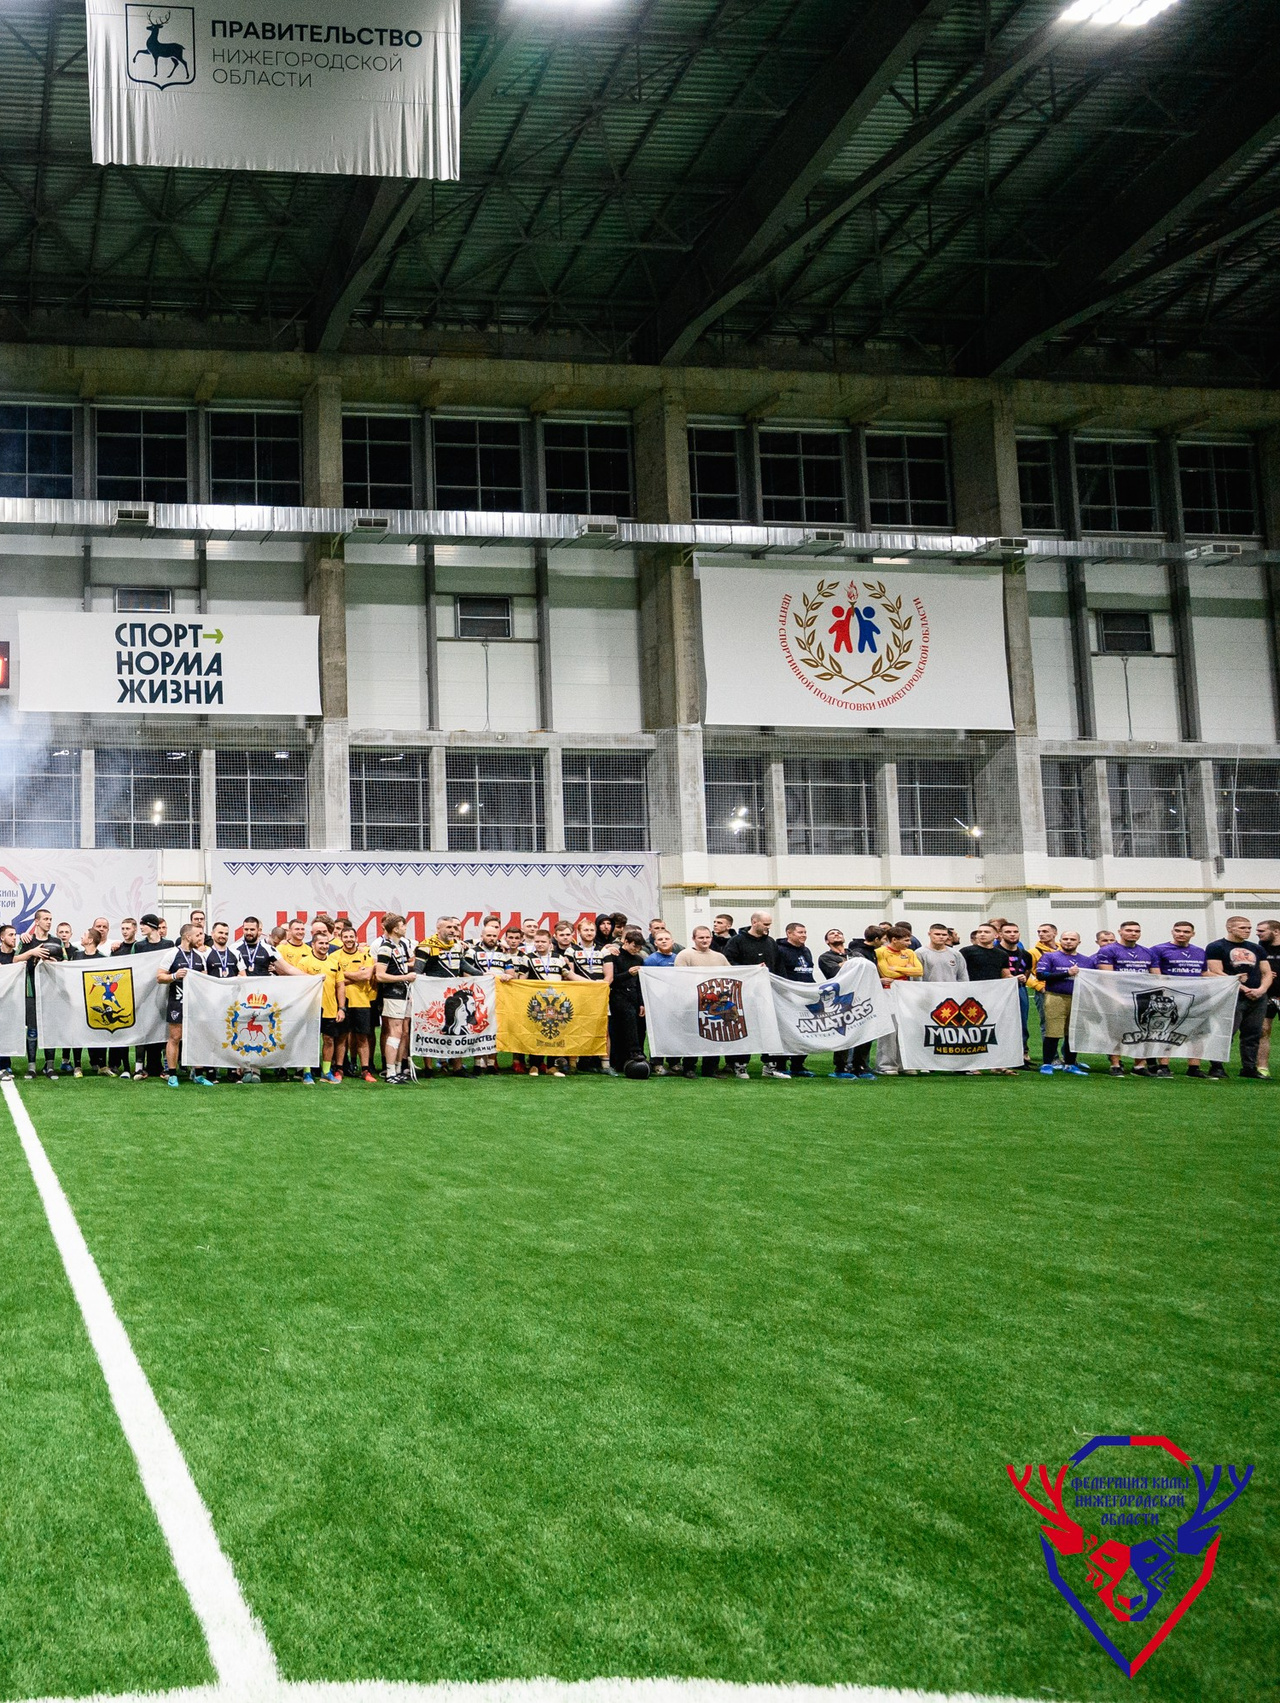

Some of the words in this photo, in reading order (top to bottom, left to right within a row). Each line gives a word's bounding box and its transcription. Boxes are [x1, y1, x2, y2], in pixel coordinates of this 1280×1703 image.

[211, 20, 423, 48] ПРАВИТЕЛЬСТВО
[212, 48, 402, 72] НИЖЕГОРОДСКОЙ
[212, 69, 312, 88] ОБЛАСТИ
[778, 593, 793, 627] ЦЕНТР
[913, 597, 930, 644] ОБЛАСТИ
[115, 623, 203, 647] СПОРТ
[116, 651, 223, 676] НОРМА
[778, 628, 814, 690] СПОРТИВНОЙ
[877, 645, 929, 709] НИЖЕГОРОДСКОЙ
[117, 679, 223, 704] ЖИЗНИ
[813, 687, 876, 711] ПОДГОТОВКИ
[796, 1001, 873, 1034] AVIATORS
[416, 1034, 452, 1045] Русское
[927, 1025, 995, 1045] МОЛОТ
[1122, 1031, 1187, 1046] ДРУЖИНА
[936, 1046, 987, 1054] ЧЕБОКСАРЫ
